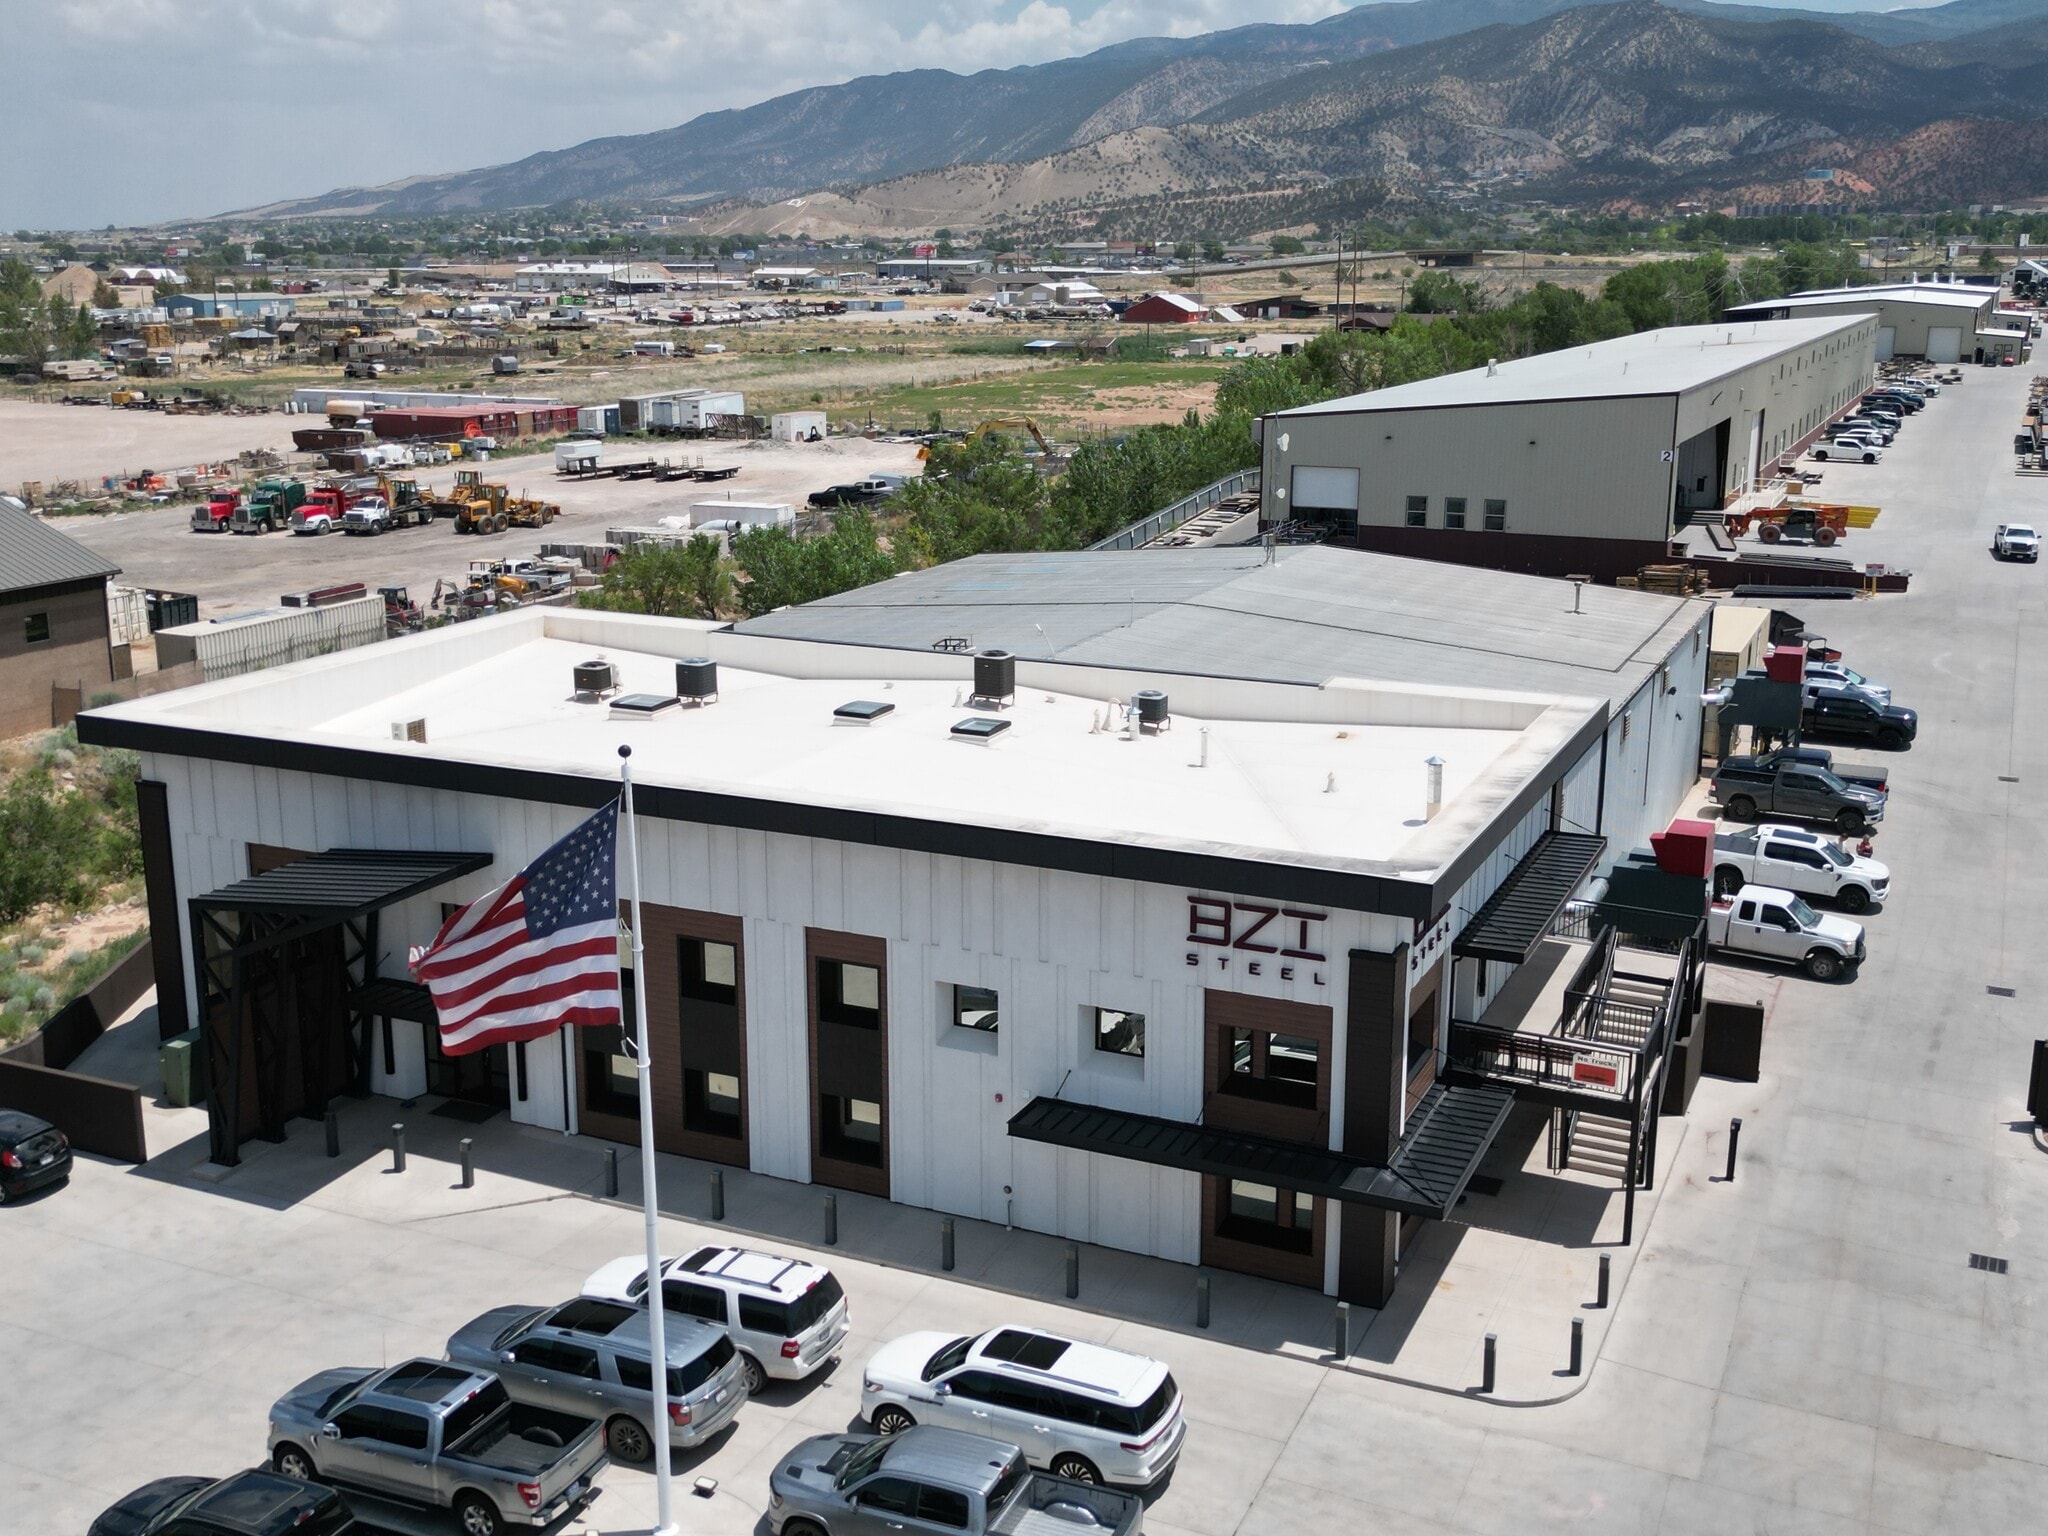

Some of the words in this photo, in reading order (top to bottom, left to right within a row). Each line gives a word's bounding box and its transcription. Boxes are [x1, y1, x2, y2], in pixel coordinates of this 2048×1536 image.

[1663, 451, 1671, 461] 2
[1186, 896, 1328, 962] BZT
[1411, 922, 1450, 970] STEEL
[1186, 953, 1325, 985] STEEL
